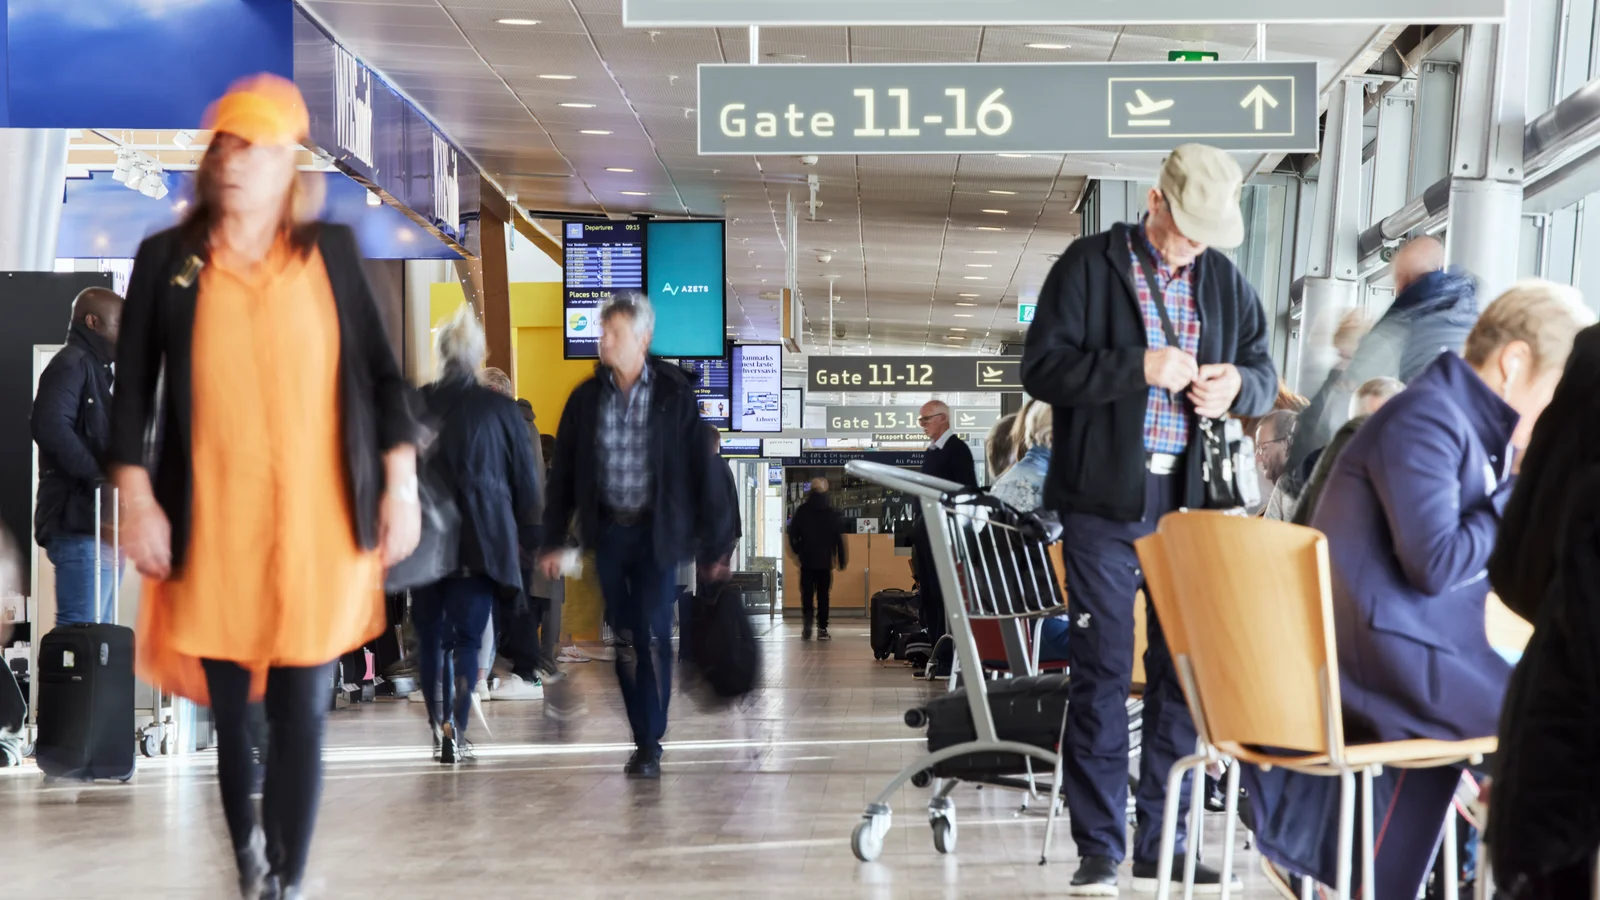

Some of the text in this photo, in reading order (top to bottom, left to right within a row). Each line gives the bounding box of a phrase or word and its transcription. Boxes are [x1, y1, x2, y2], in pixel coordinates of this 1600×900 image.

[720, 87, 1013, 137] Gate 11-16
[585, 224, 613, 232] Departures
[681, 285, 709, 293] AZETS
[816, 364, 934, 386] Gate 11-12
[832, 417, 869, 429] Gate
[875, 433, 904, 441] Passport
